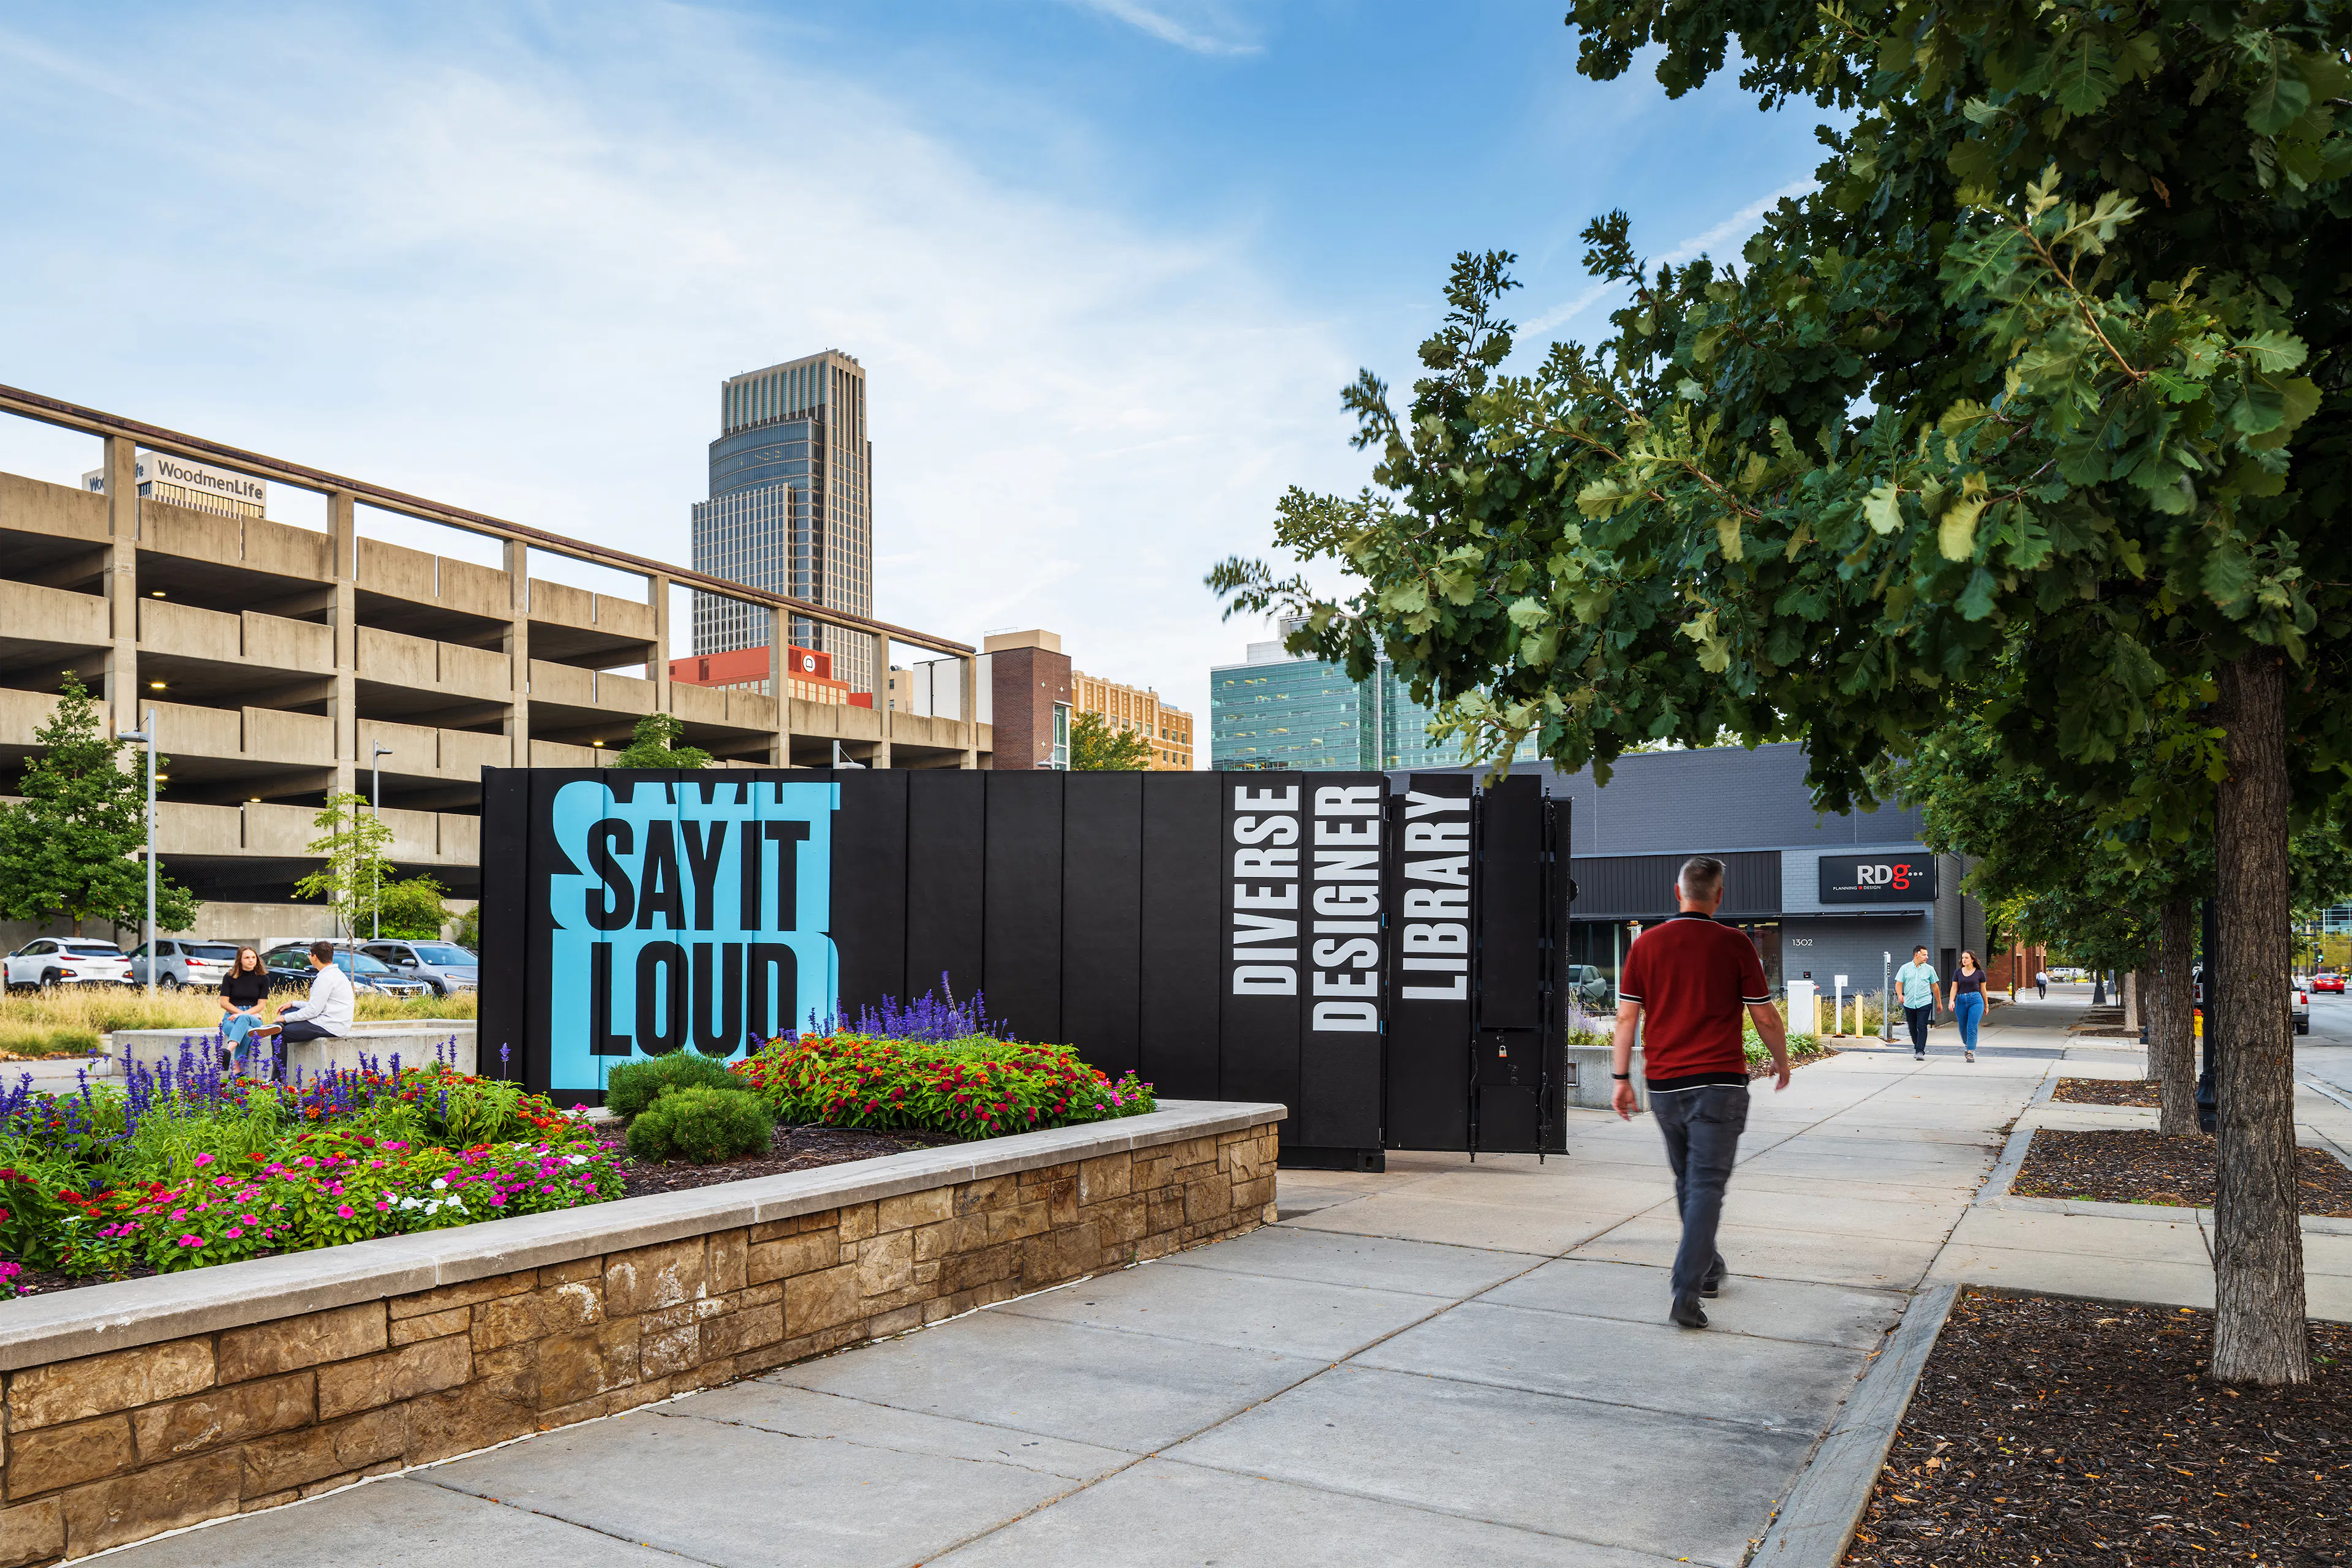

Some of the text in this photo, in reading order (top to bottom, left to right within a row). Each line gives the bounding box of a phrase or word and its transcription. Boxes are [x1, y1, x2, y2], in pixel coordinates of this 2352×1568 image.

[158, 459, 263, 499] WoodmenLife
[585, 818, 810, 932] SAY IT
[1233, 785, 1300, 995] DIVERSE
[1312, 785, 1380, 1032] DESIGNER
[1402, 791, 1470, 1000] LIBRARY
[590, 941, 798, 1058] LOUD
